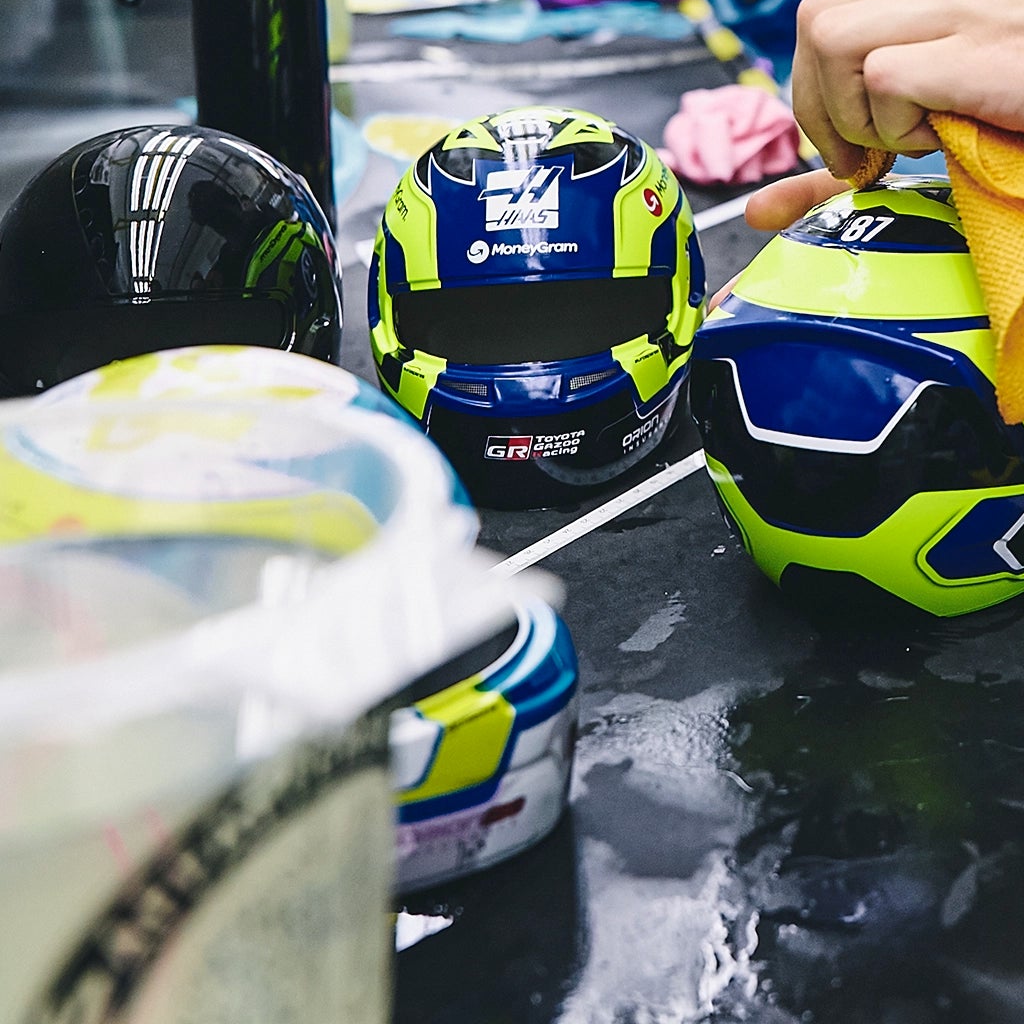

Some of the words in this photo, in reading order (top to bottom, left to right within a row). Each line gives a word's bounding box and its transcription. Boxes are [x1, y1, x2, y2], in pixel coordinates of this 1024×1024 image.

[486, 209, 559, 226] HAAS
[840, 215, 895, 243] 87
[491, 240, 579, 257] MoneyGram
[535, 429, 586, 443] TOYOTA
[533, 438, 581, 451] GAZOO
[486, 445, 529, 459] GR
[532, 446, 578, 458] Racing
